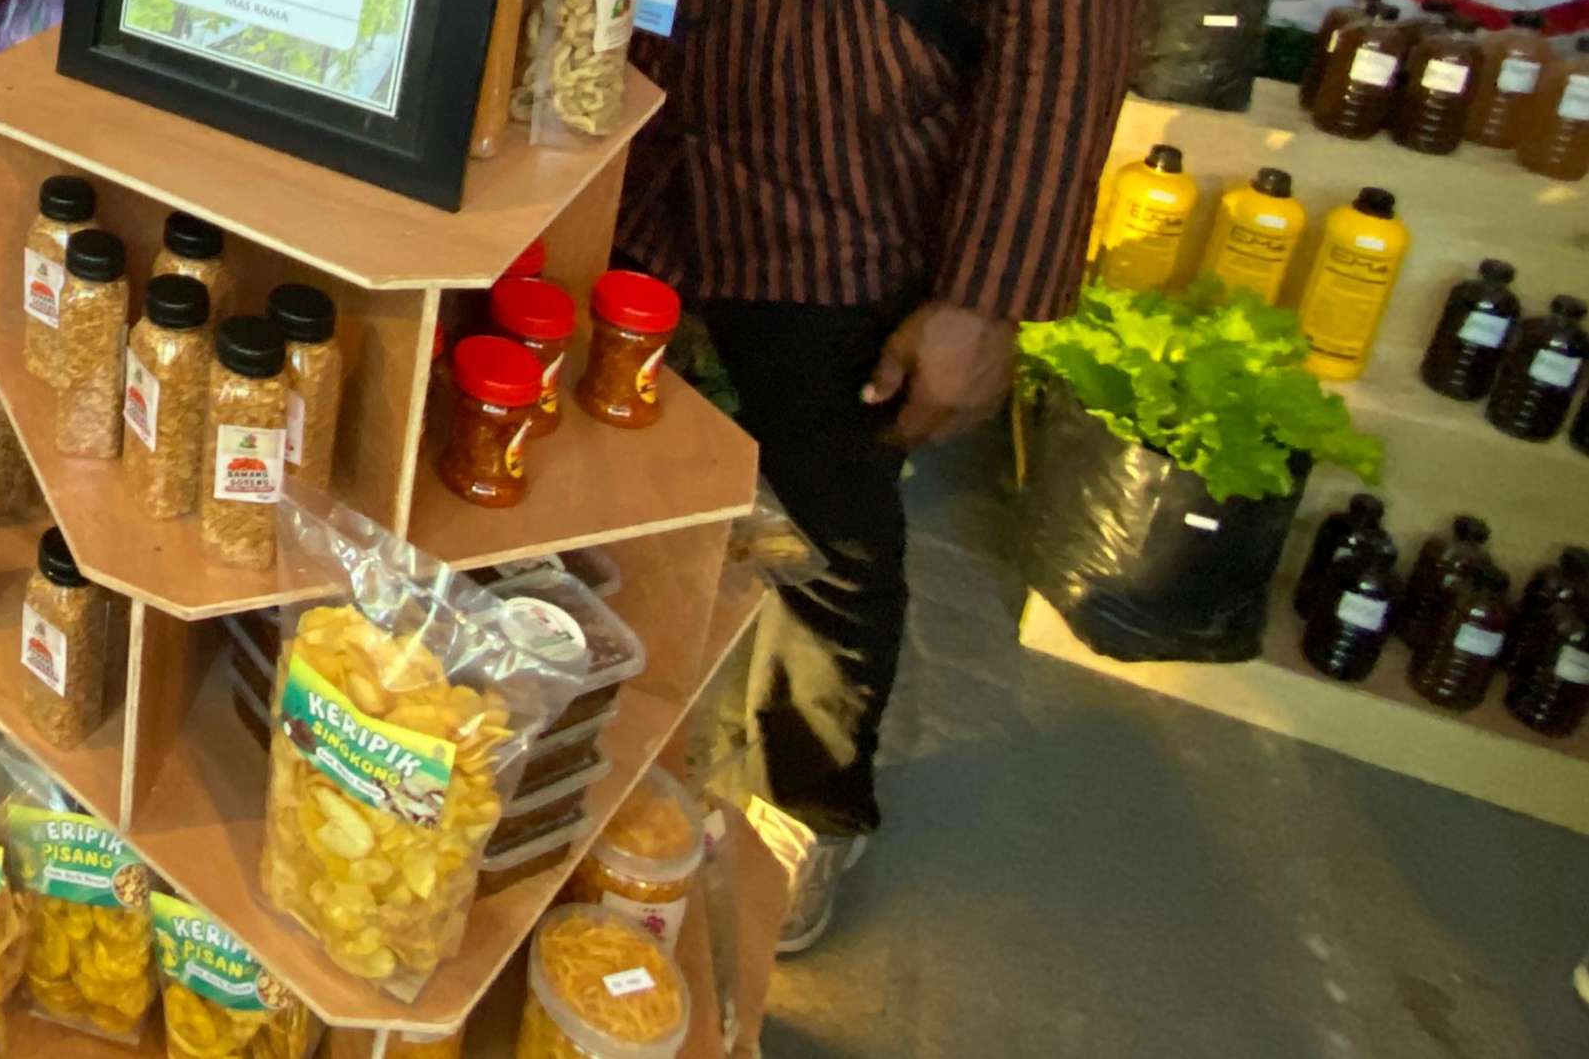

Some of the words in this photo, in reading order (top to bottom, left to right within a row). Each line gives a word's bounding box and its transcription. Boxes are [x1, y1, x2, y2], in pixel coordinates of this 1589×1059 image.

[254, 4, 290, 23] RAMA
[308, 692, 423, 777] KERIPIK
[43, 843, 113, 869] PISANG
[183, 939, 253, 979] PISAN
